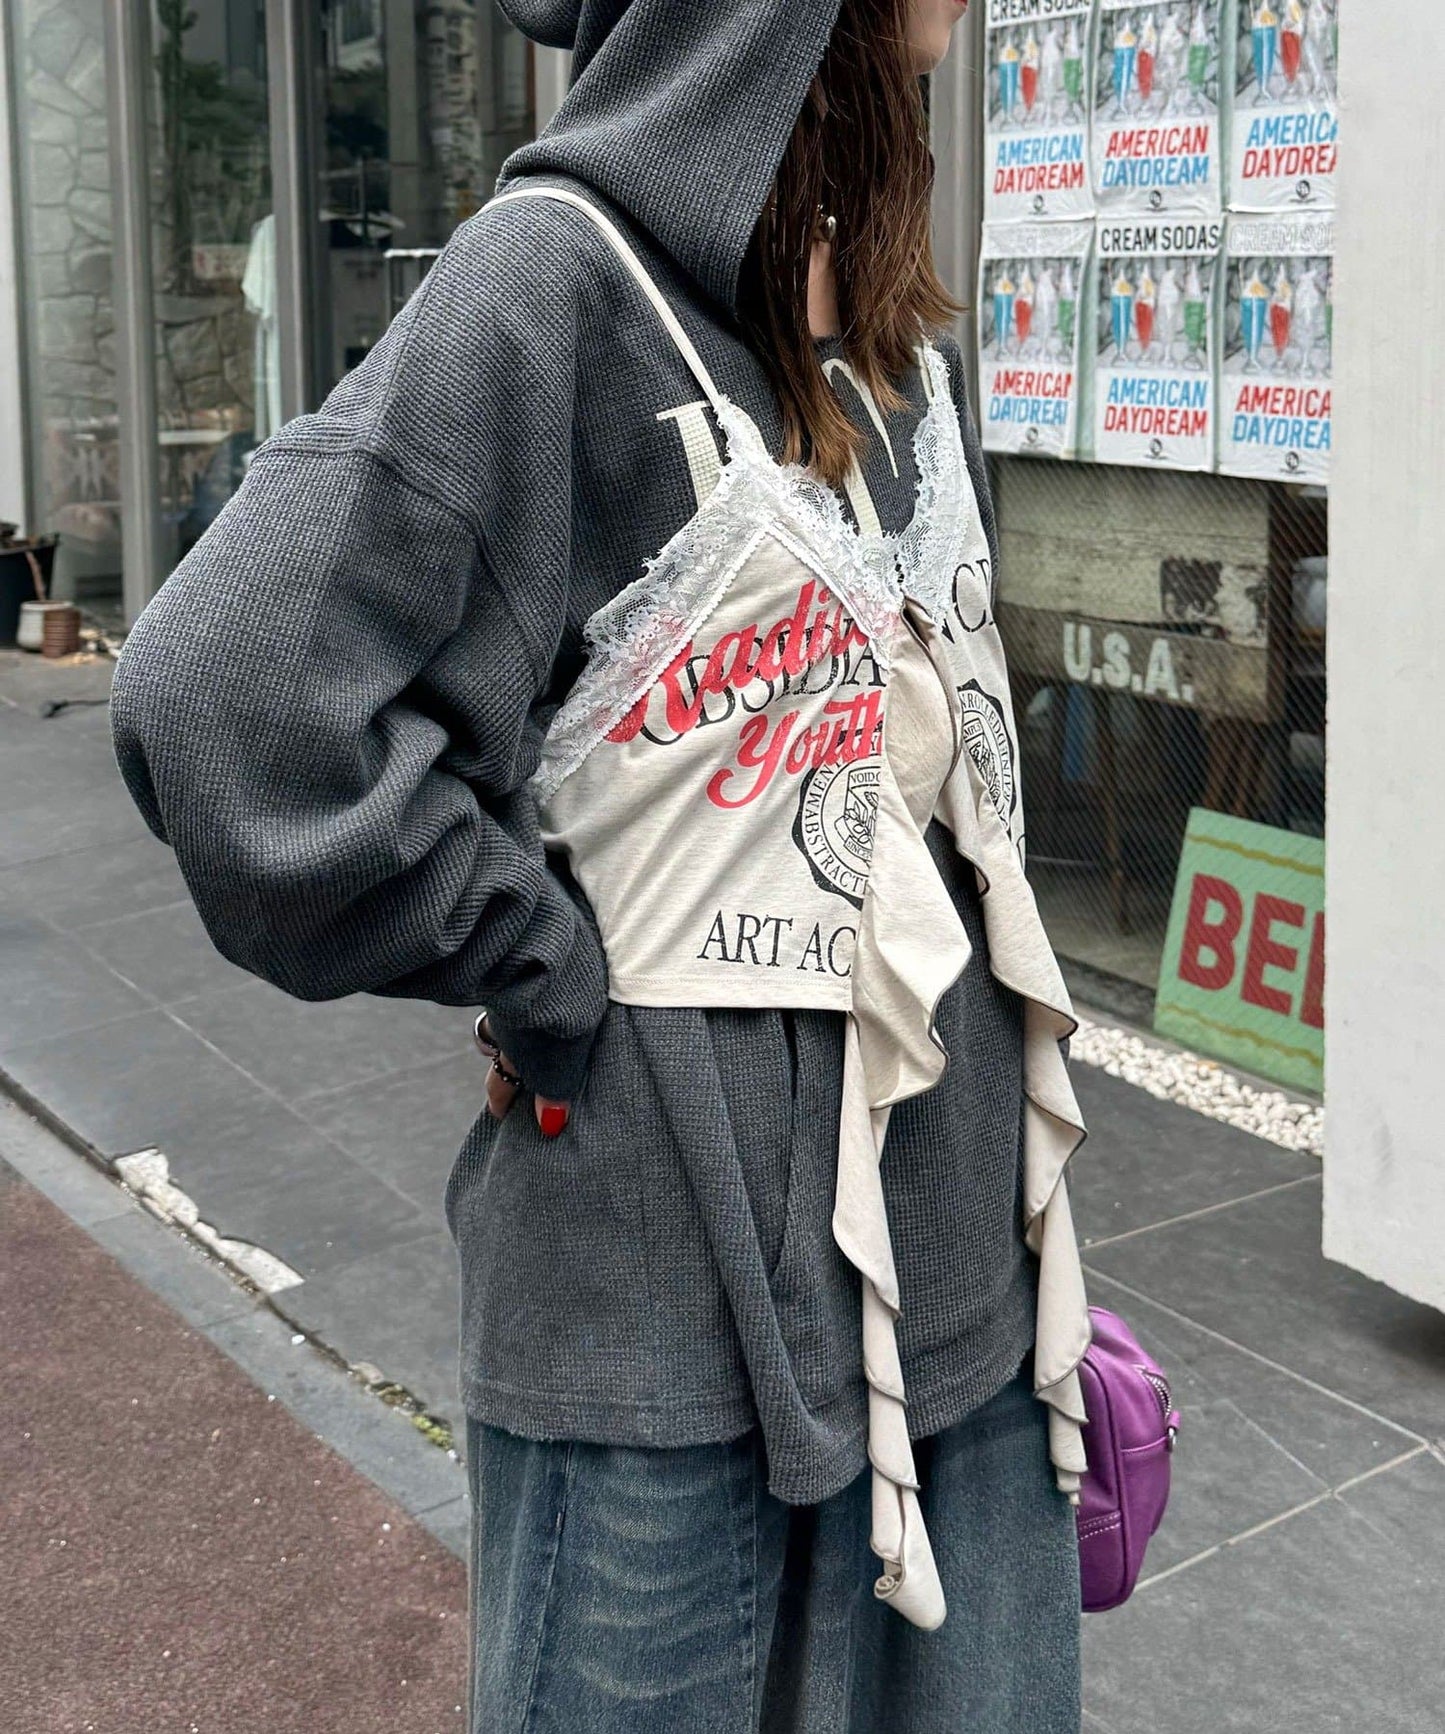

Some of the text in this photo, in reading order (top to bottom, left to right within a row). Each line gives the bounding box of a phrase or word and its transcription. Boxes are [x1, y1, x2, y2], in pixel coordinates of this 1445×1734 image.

[996, 133, 1084, 167] AMERICAN
[1105, 125, 1209, 157] AMERICAN
[993, 162, 1084, 194] DAYDREAM
[1102, 155, 1209, 187] DAYDREAM
[1101, 227, 1156, 251] CREAM
[1161, 224, 1219, 249] SODAS
[1107, 377, 1207, 408] AMERICAN
[1104, 405, 1207, 437] DAYDREAM
[1063, 621, 1195, 703] U.S.A.
[705, 690, 885, 809] Youth
[696, 909, 793, 967] ART
